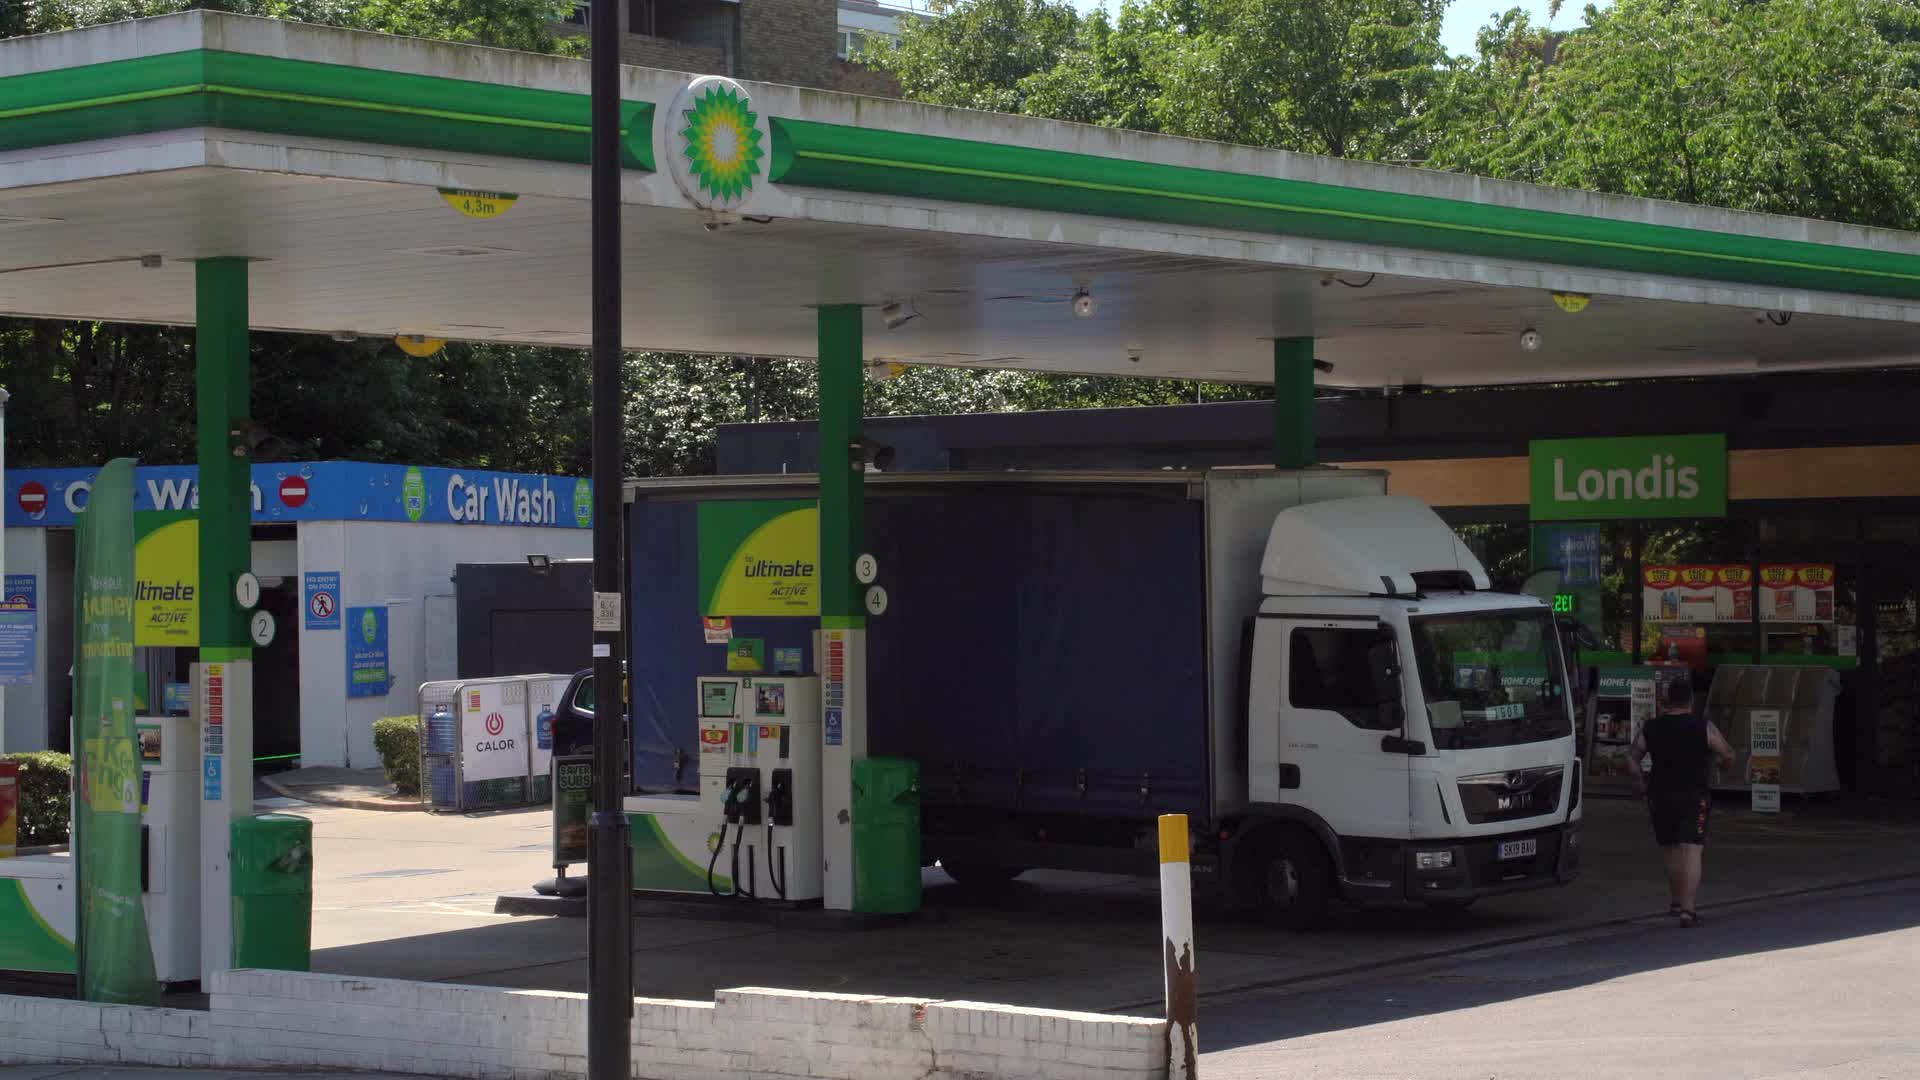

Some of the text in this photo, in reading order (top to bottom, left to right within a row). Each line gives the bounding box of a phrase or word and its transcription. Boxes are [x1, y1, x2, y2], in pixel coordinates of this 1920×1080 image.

[1553, 454, 1699, 501] Londis
[447, 473, 556, 524] Car Wash
[744, 560, 814, 578] ultimate
[862, 560, 871, 577] 3
[136, 580, 195, 601] ltimate
[243, 581, 251, 600] 1
[769, 586, 808, 596] ACTIVE
[871, 592, 881, 609] 4
[150, 612, 190, 623] ACTIVE
[258, 619, 268, 637] 2
[1599, 677, 1625, 687] HOME
[476, 739, 515, 752] CALOR
[559, 764, 591, 776] SAVER
[559, 775, 591, 788] SUBS
[1504, 843, 1520, 857] SK19
[1191, 864, 1213, 873] AN
